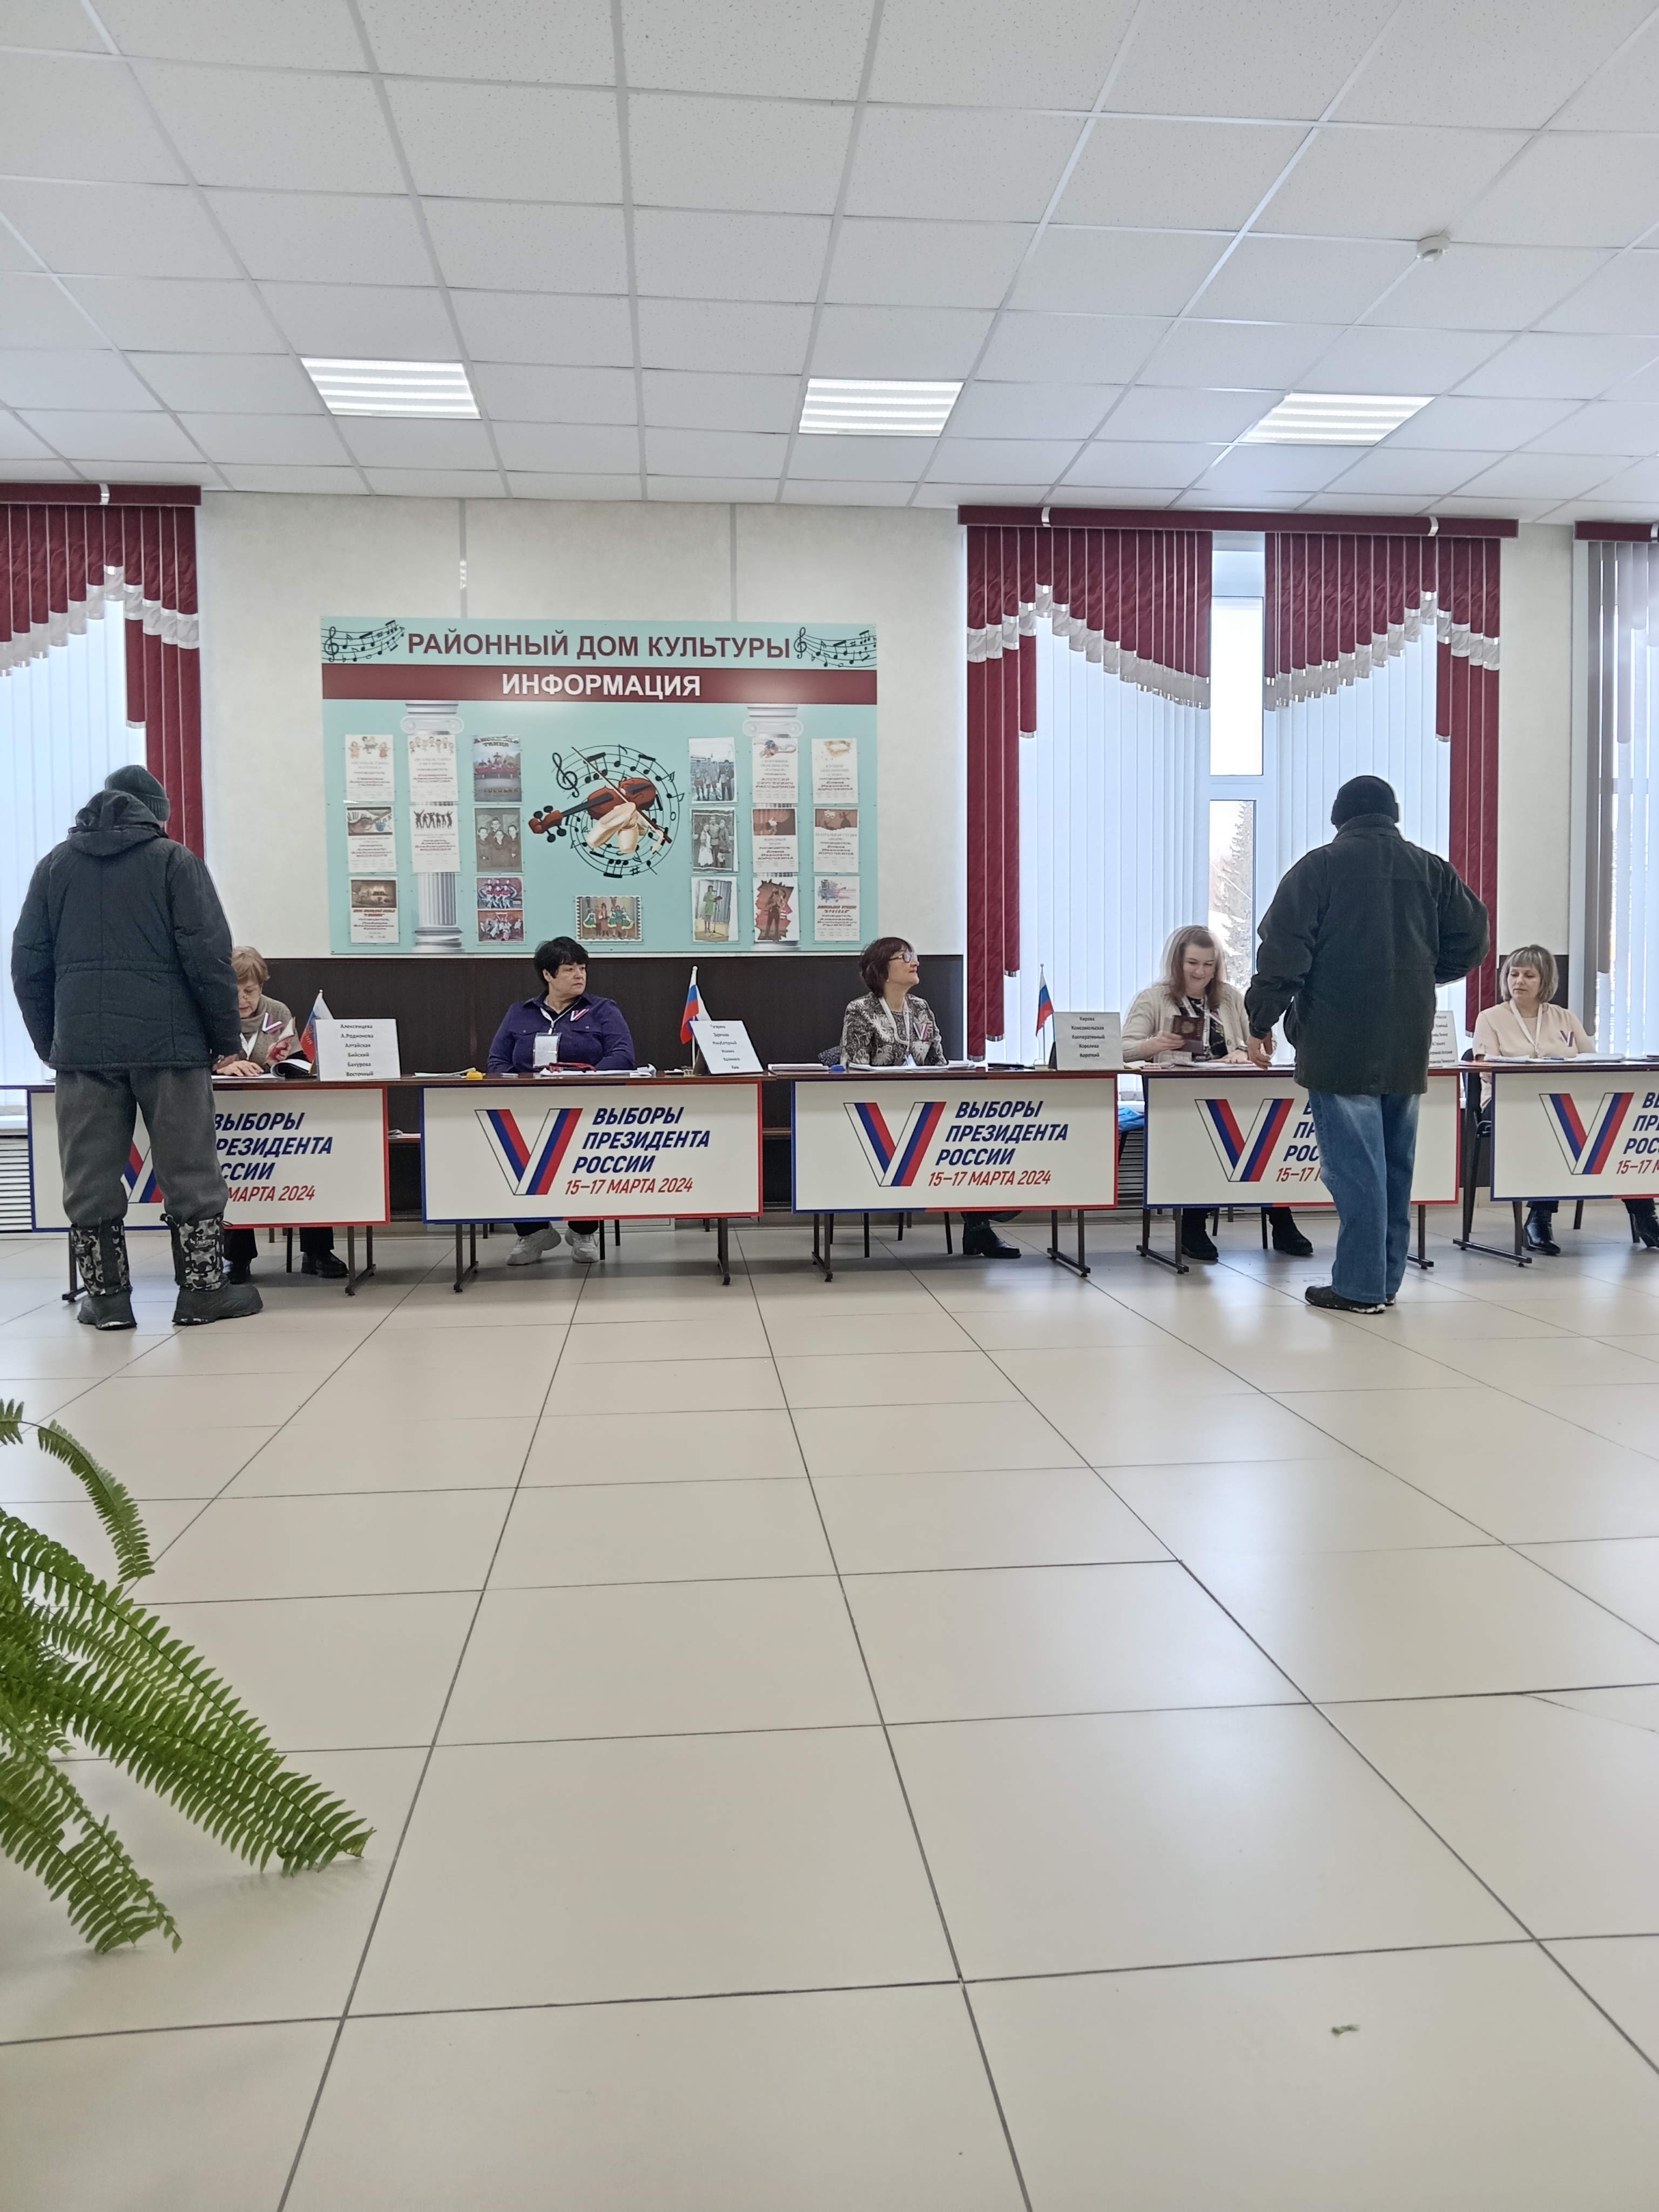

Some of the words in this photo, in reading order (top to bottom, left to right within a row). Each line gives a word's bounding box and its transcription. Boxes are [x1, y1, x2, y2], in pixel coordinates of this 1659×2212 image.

[408, 629, 568, 655] РАЙОННЫЙ
[577, 635, 639, 660] ДОМ
[648, 637, 790, 658] КУЛЬТУРЫ
[502, 673, 701, 699] ИНФОРМАЦИЯ
[592, 1107, 684, 1125] ВЫБОРЫ
[955, 1101, 1044, 1118] ВЫБОРЫ
[582, 1130, 710, 1151] ПРЕЗИДЕНТА
[945, 1124, 1069, 1144] ПРЕЗИДЕНТА
[216, 1137, 333, 1158] РЕЗИДЕНТА
[935, 1148, 1016, 1166] РОССИИ
[221, 1162, 275, 1181] ССИИ
[572, 1155, 656, 1174] РОССИИ
[606, 1178, 656, 1193] МАРТА
[658, 1177, 693, 1193] 2024
[967, 1171, 1016, 1186] МАРТА
[1017, 1170, 1051, 1185] 2024
[228, 1186, 276, 1202] МАРТА
[278, 1185, 315, 1201] 2024
